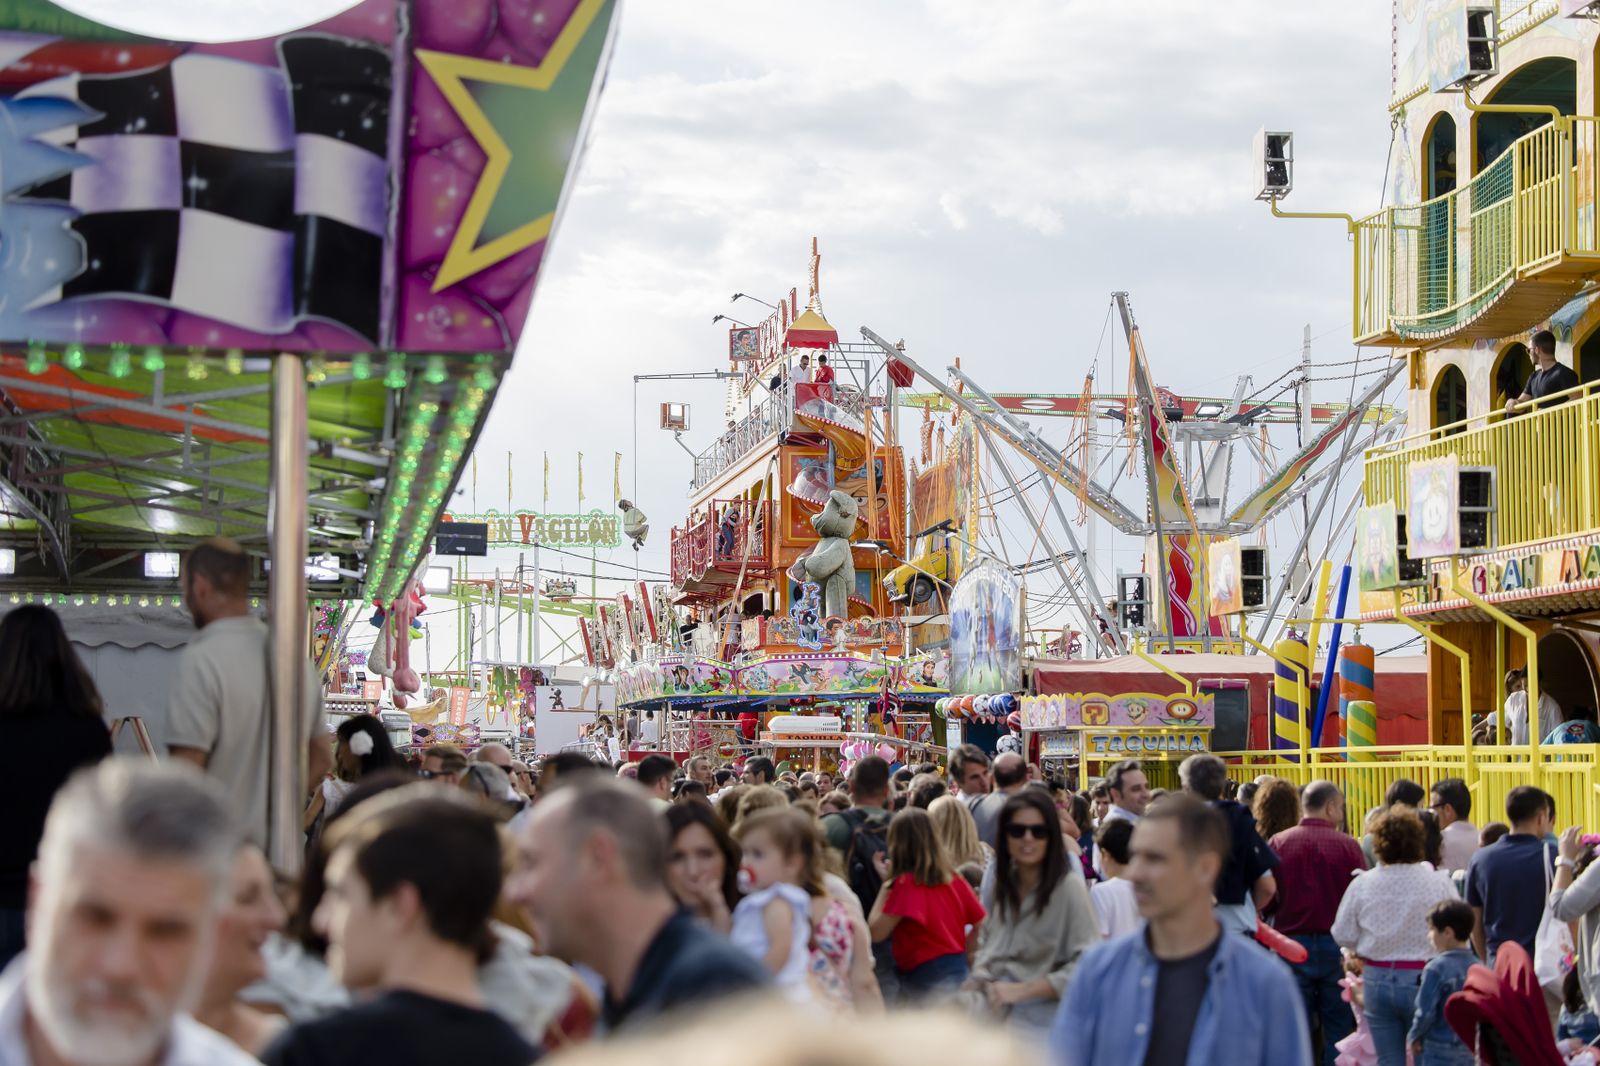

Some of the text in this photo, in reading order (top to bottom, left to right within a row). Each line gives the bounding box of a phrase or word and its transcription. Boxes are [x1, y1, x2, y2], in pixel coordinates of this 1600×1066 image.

[517, 513, 618, 544] VACILÓN
[1471, 554, 1543, 595] GRAN
[1091, 734, 1205, 752] TAQUILLA
